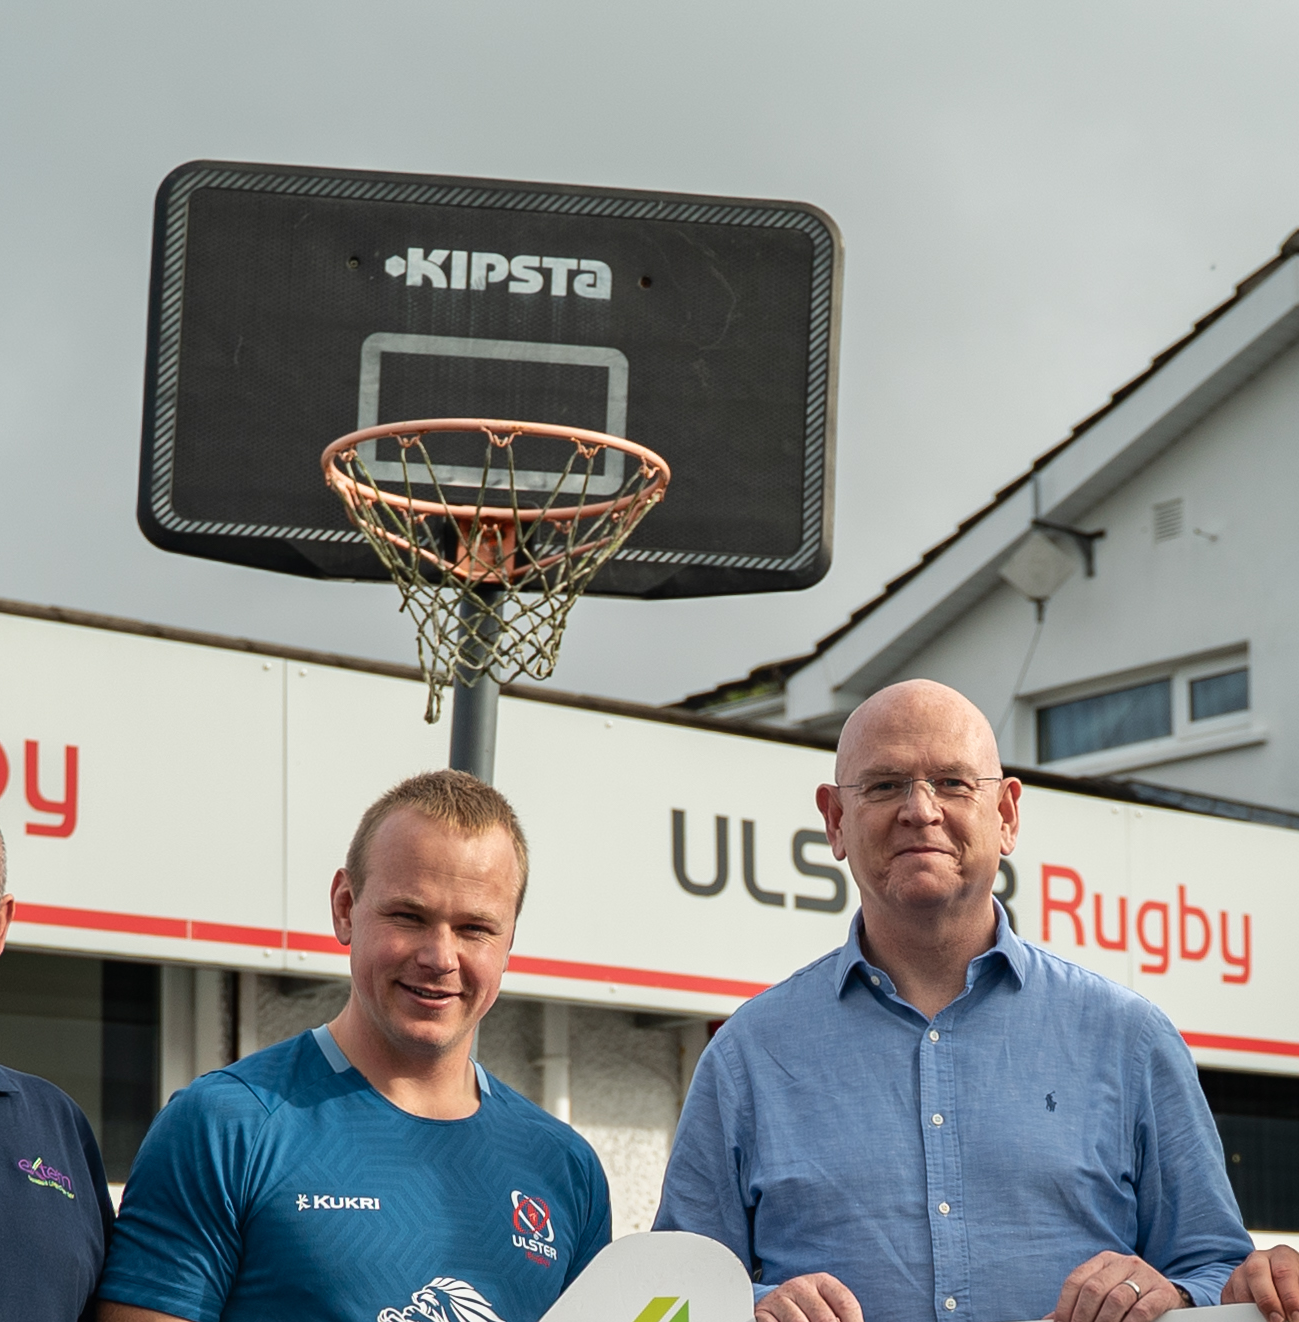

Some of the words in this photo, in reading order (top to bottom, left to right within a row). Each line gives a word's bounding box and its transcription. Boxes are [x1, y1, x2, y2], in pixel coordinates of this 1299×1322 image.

[671, 808, 1018, 936] ULSR
[1041, 864, 1252, 984] Rugby
[313, 1194, 381, 1211] KUKRI
[511, 1234, 558, 1261] ULSTER
